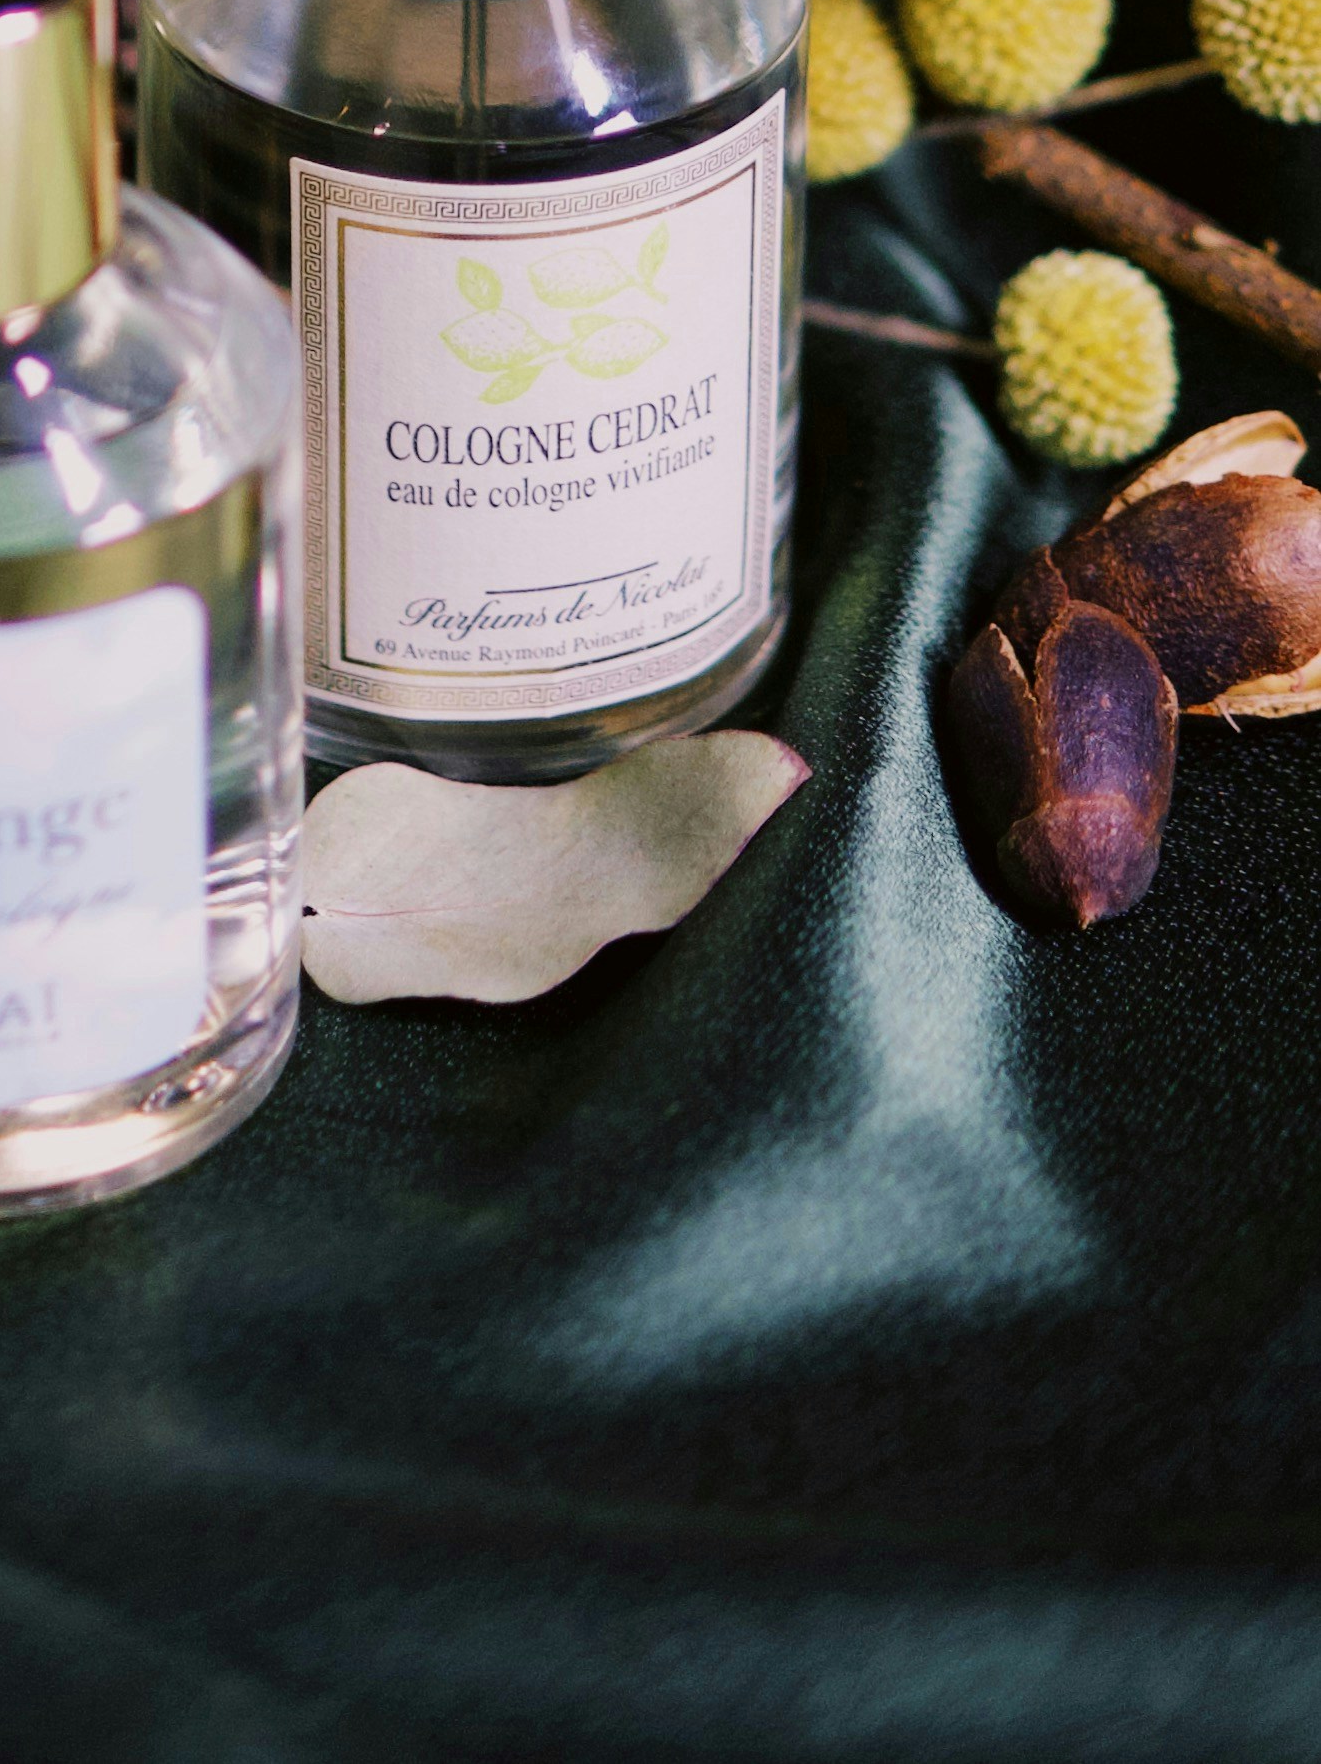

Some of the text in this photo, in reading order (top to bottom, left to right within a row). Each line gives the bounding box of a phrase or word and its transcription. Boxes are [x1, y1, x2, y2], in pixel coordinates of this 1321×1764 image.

[385, 374, 718, 466] COLOGNE CEDRAT
[387, 434, 716, 512] eau de cologne vivifiante
[399, 597, 547, 641] Parfums
[555, 590, 595, 623] de
[374, 638, 397, 655] 69
[402, 643, 471, 662] Avenue
[478, 644, 566, 665] Raymond
